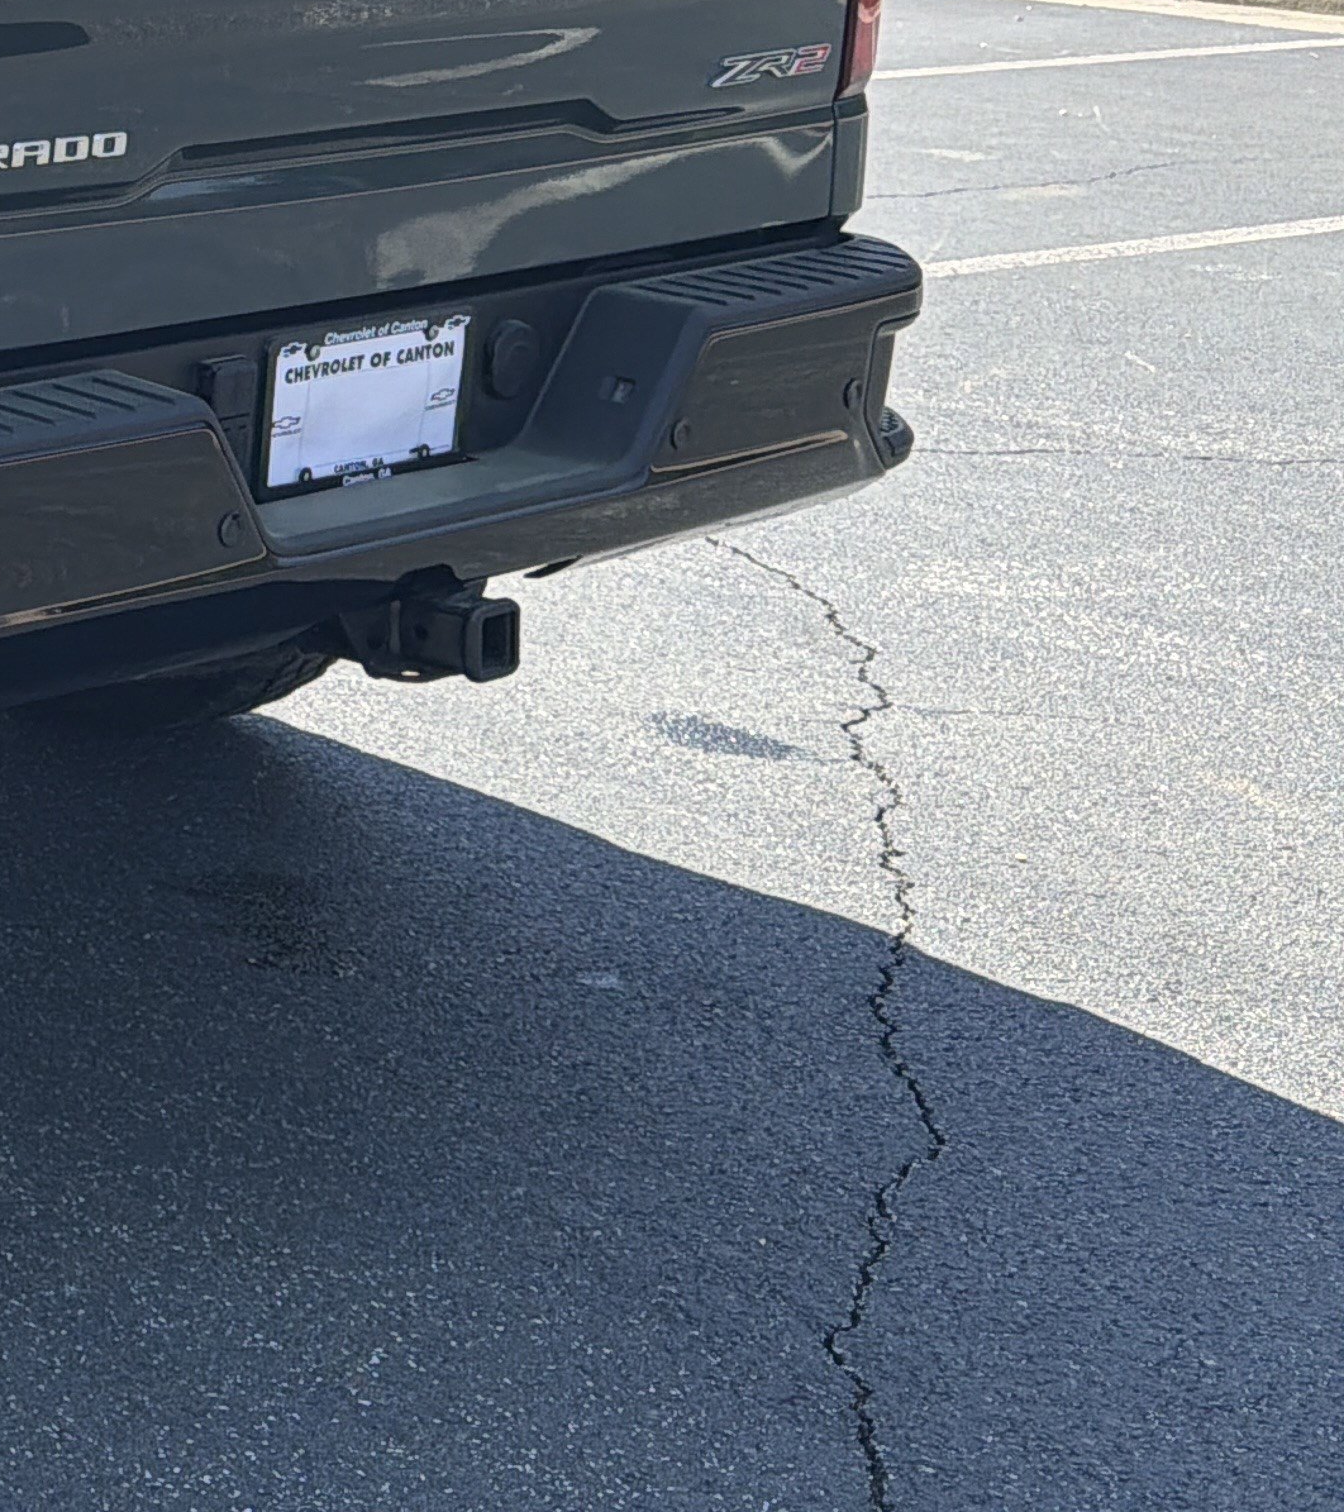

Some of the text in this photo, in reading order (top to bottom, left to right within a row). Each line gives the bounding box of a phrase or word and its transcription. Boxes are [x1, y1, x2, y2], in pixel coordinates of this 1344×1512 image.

[710, 42, 832, 88] ZR2
[324, 319, 429, 345] Chevrolet of Canton
[285, 340, 455, 384] CHEVROLET OF CANTON
